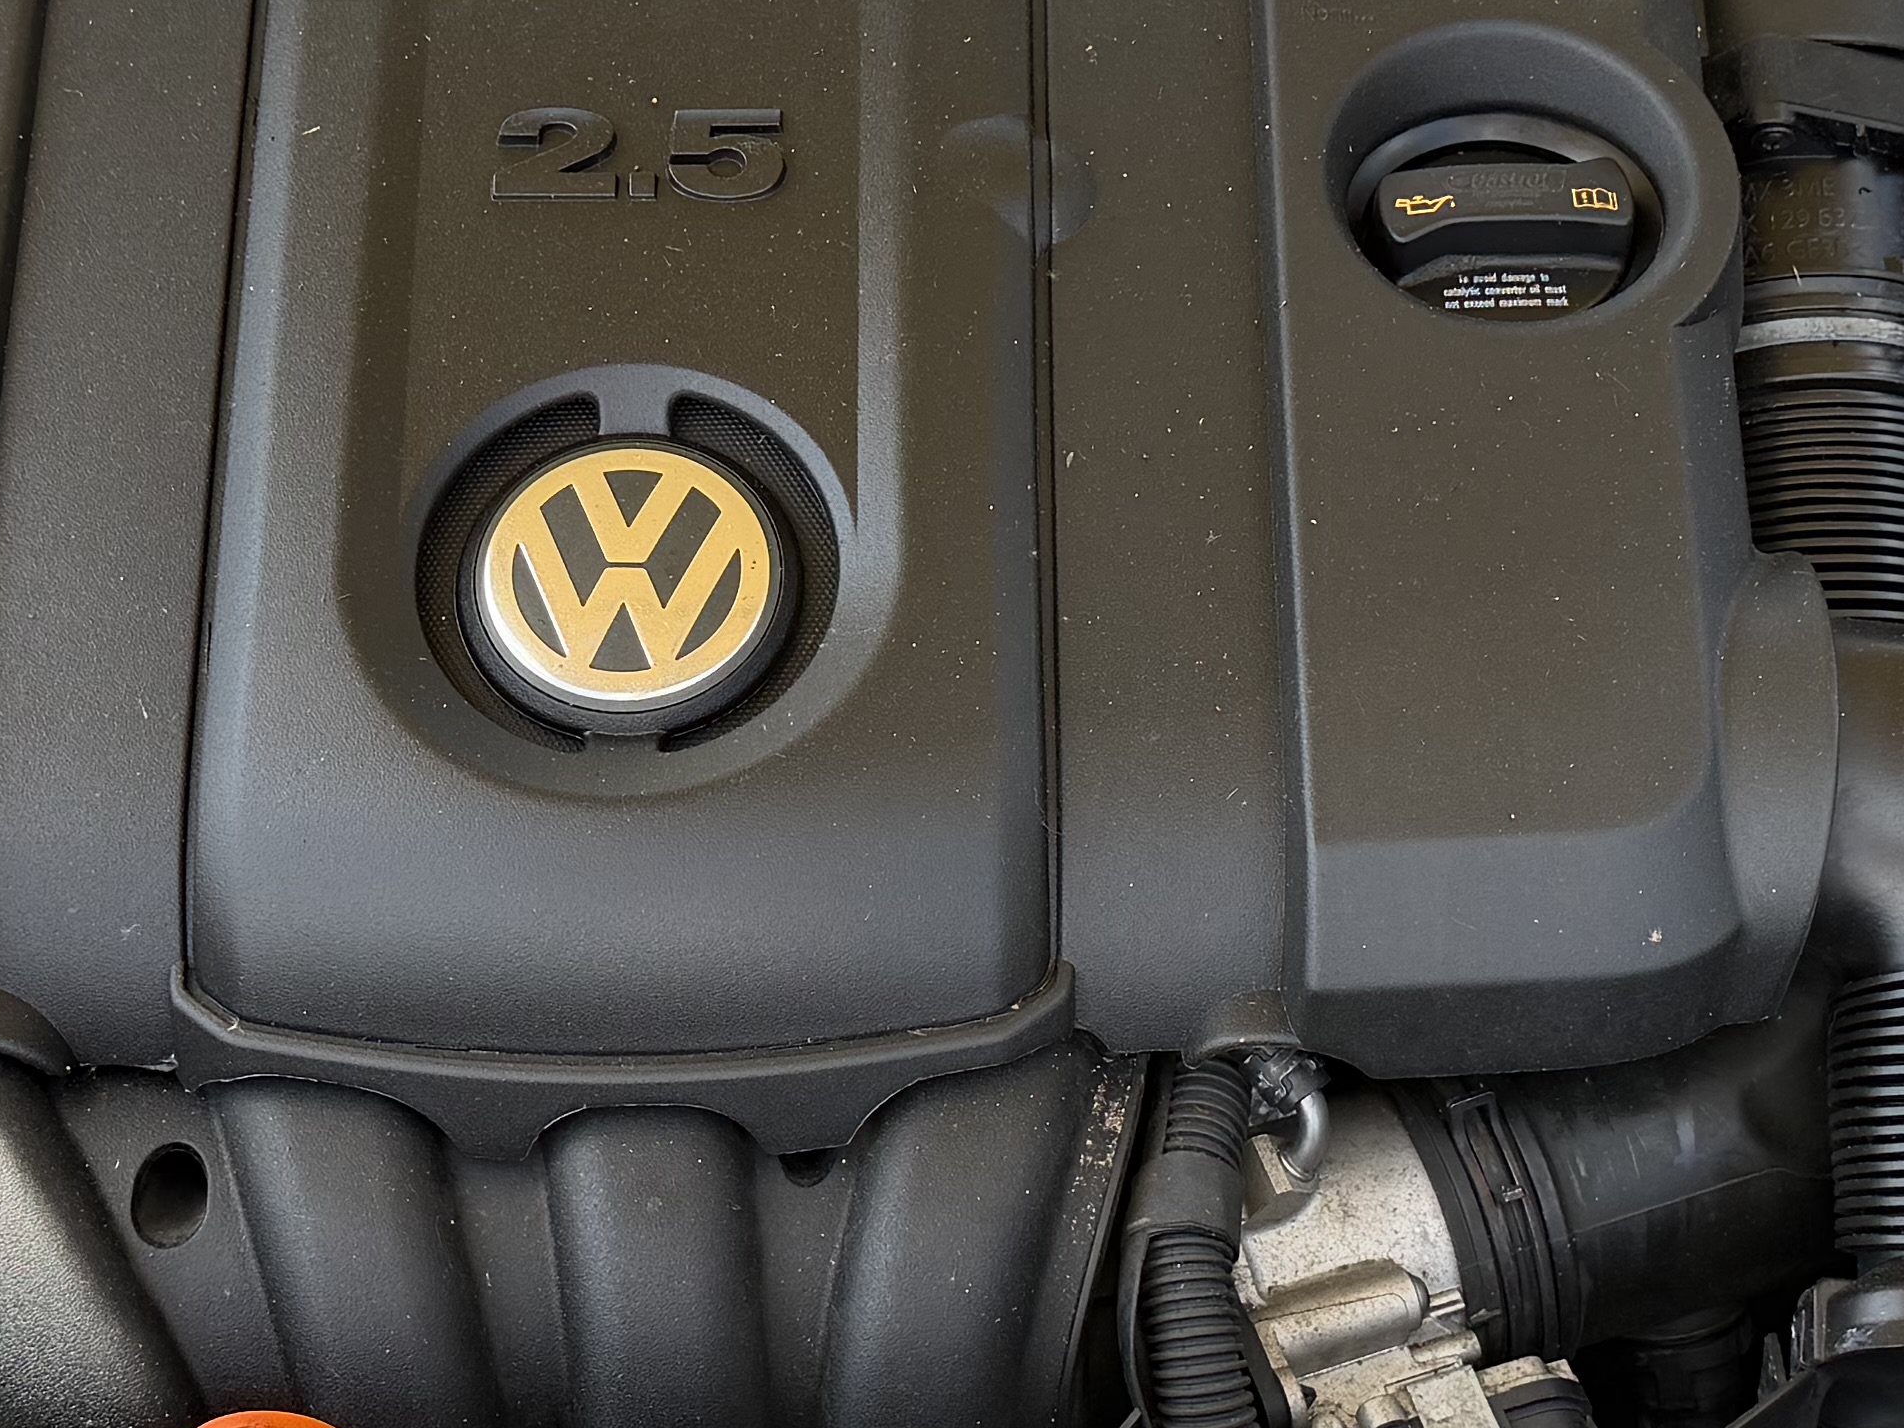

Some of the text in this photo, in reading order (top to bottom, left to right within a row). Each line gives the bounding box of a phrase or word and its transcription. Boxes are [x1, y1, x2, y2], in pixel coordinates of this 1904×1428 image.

[491, 106, 787, 202] 2.5
[1473, 274, 1497, 283] avoid
[1501, 274, 1535, 284] damage
[1443, 286, 1481, 297] catalytic
[1484, 285, 1526, 294] converter
[1545, 285, 1567, 294] must
[1445, 298, 1569, 309] not exceed maximum mark
[491, 452, 765, 694] VW
